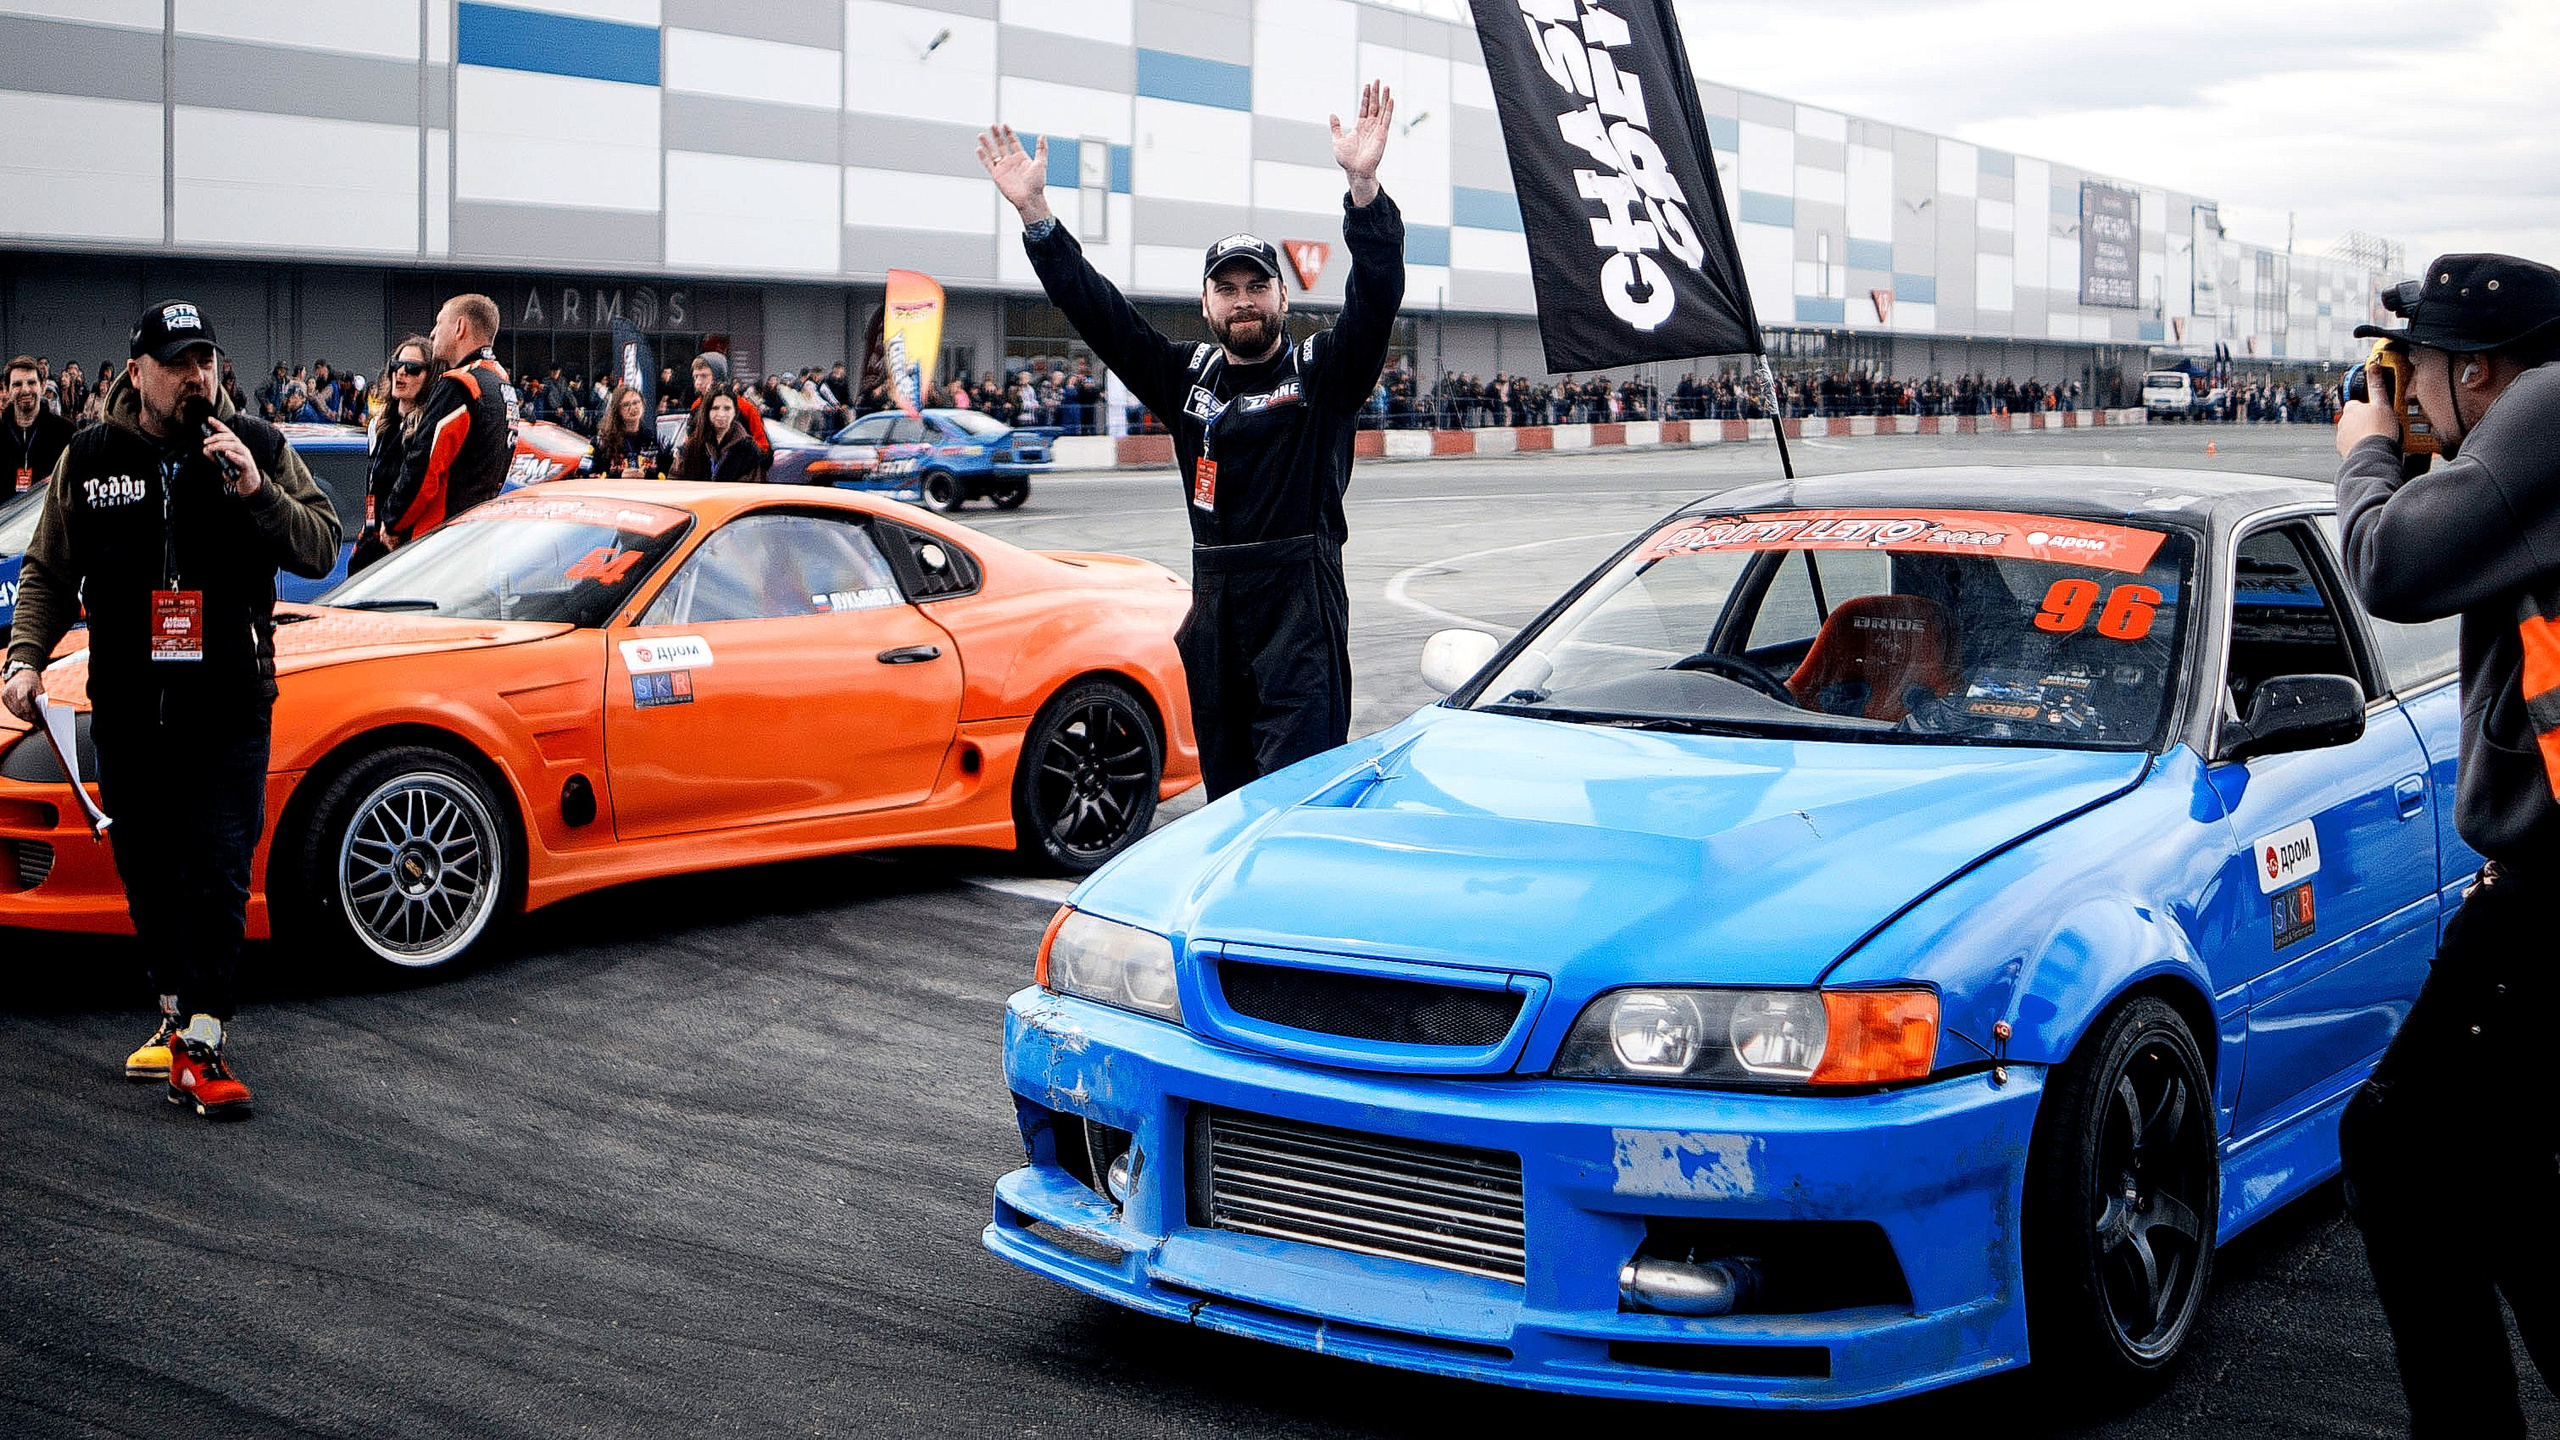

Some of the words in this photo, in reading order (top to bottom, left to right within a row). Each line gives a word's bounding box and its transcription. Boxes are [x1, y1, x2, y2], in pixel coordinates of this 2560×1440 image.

[1298, 246, 1321, 273] 14
[83, 474, 146, 503] Teddy
[1655, 519, 1809, 550] DRIFT
[2033, 578, 2162, 640] 96
[636, 674, 689, 697] SKR
[2280, 836, 2312, 875] дром
[2275, 890, 2311, 930] SKR
